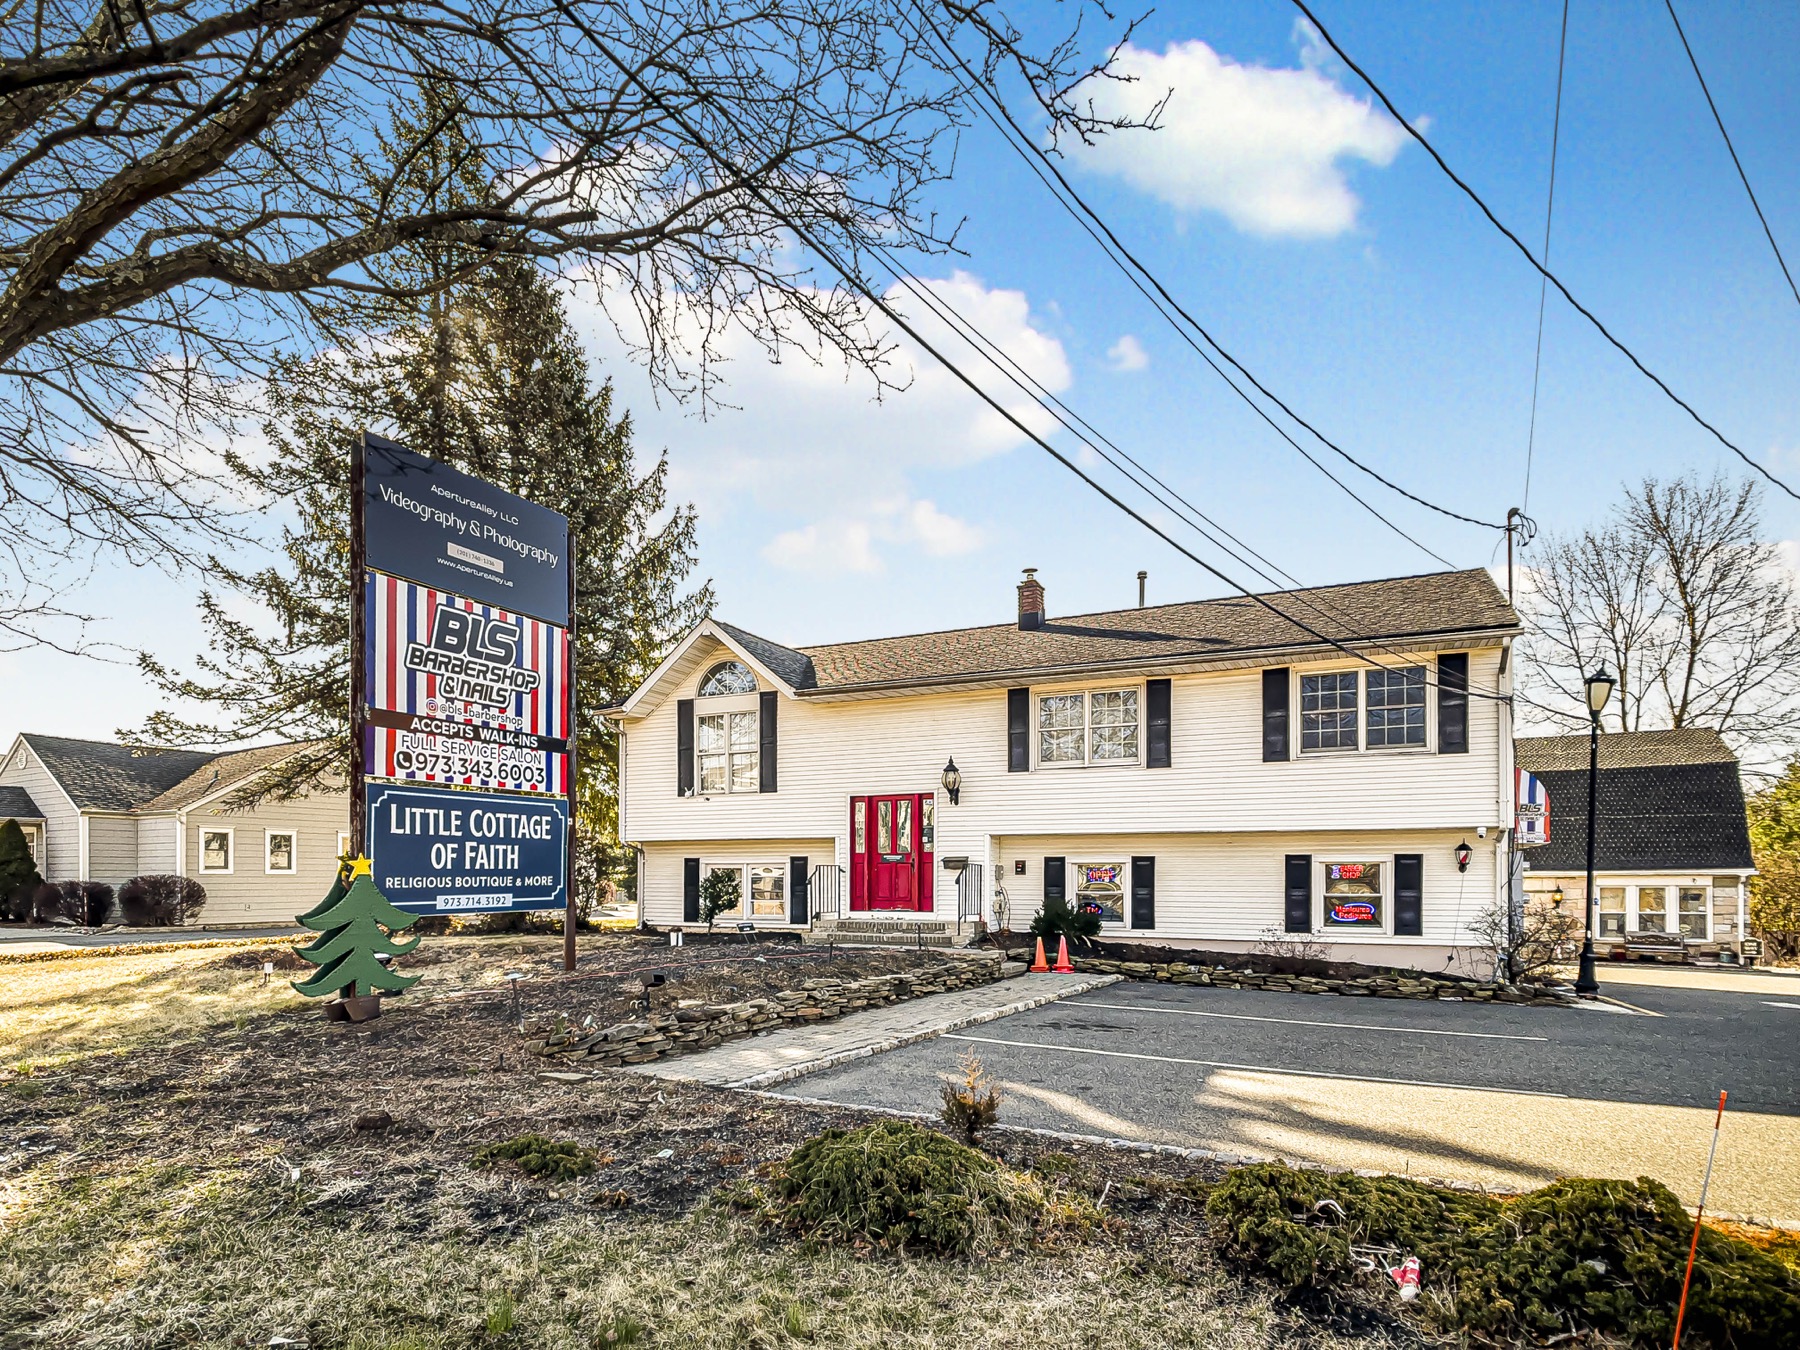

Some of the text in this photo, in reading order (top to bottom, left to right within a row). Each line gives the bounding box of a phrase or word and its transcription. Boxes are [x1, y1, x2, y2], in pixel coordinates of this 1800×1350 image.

[430, 484, 519, 526] ApertureAlley LLC
[379, 483, 559, 569] Videography & Photography
[433, 606, 520, 666] BLS
[407, 646, 539, 691] BARBERSHOP
[442, 677, 509, 706] & NAILS
[439, 704, 523, 727] @bls_barbershop
[410, 717, 538, 748] ACCEPTS WALK-INS
[401, 734, 542, 765] FULL SERVICE SALON
[415, 752, 546, 784] 973.343.6003
[390, 803, 552, 840] LITTLE COTTAGE
[1519, 804, 1542, 813] BLS
[430, 841, 520, 870] OF FAITH
[385, 875, 553, 889] RELIGIOUS BOUTIQUE & MORE
[1089, 870, 1113, 880] OPEN
[443, 896, 507, 908] 973.714.3192
